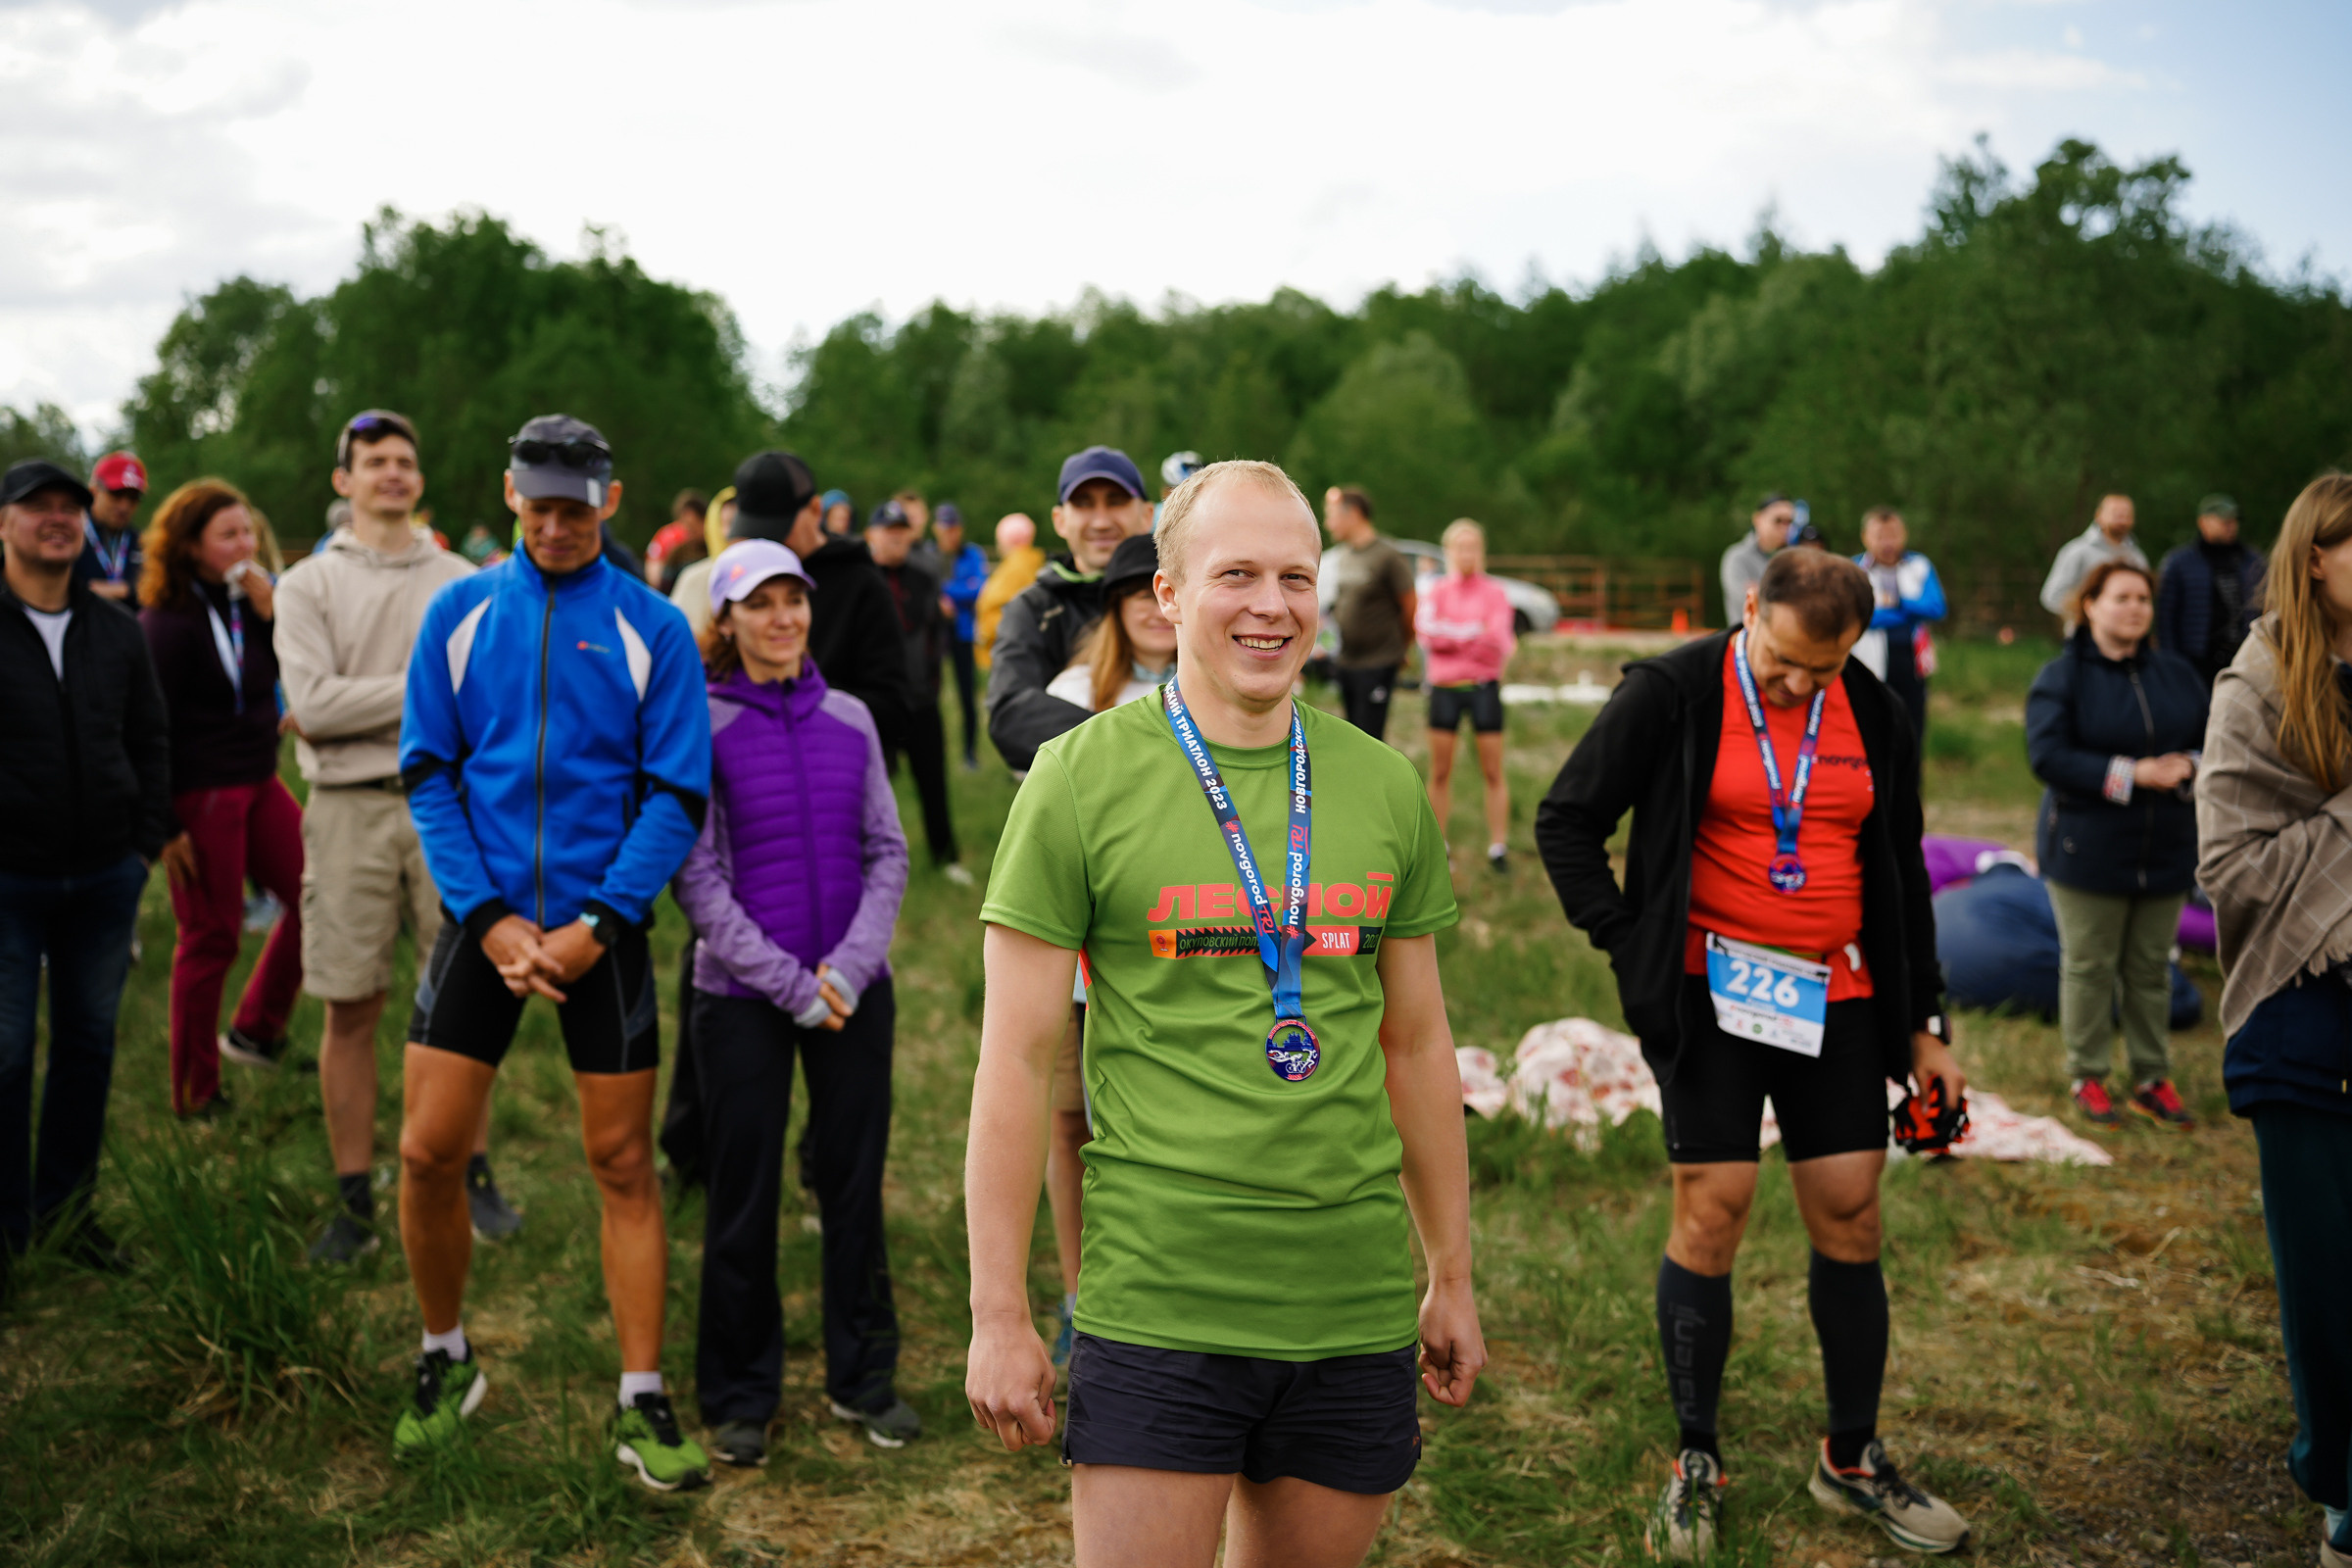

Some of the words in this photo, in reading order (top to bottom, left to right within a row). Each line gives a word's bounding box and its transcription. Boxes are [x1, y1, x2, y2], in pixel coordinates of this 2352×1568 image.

[1176, 715, 1212, 777] ТРИАТЛОН
[1205, 778, 1228, 810] 2023
[1294, 716, 1308, 814] НОВГОРОДСКИЙ
[1239, 936, 1259, 948] ПОЛ
[1321, 932, 1350, 949] SPLAT
[1726, 958, 1800, 1008] 226
